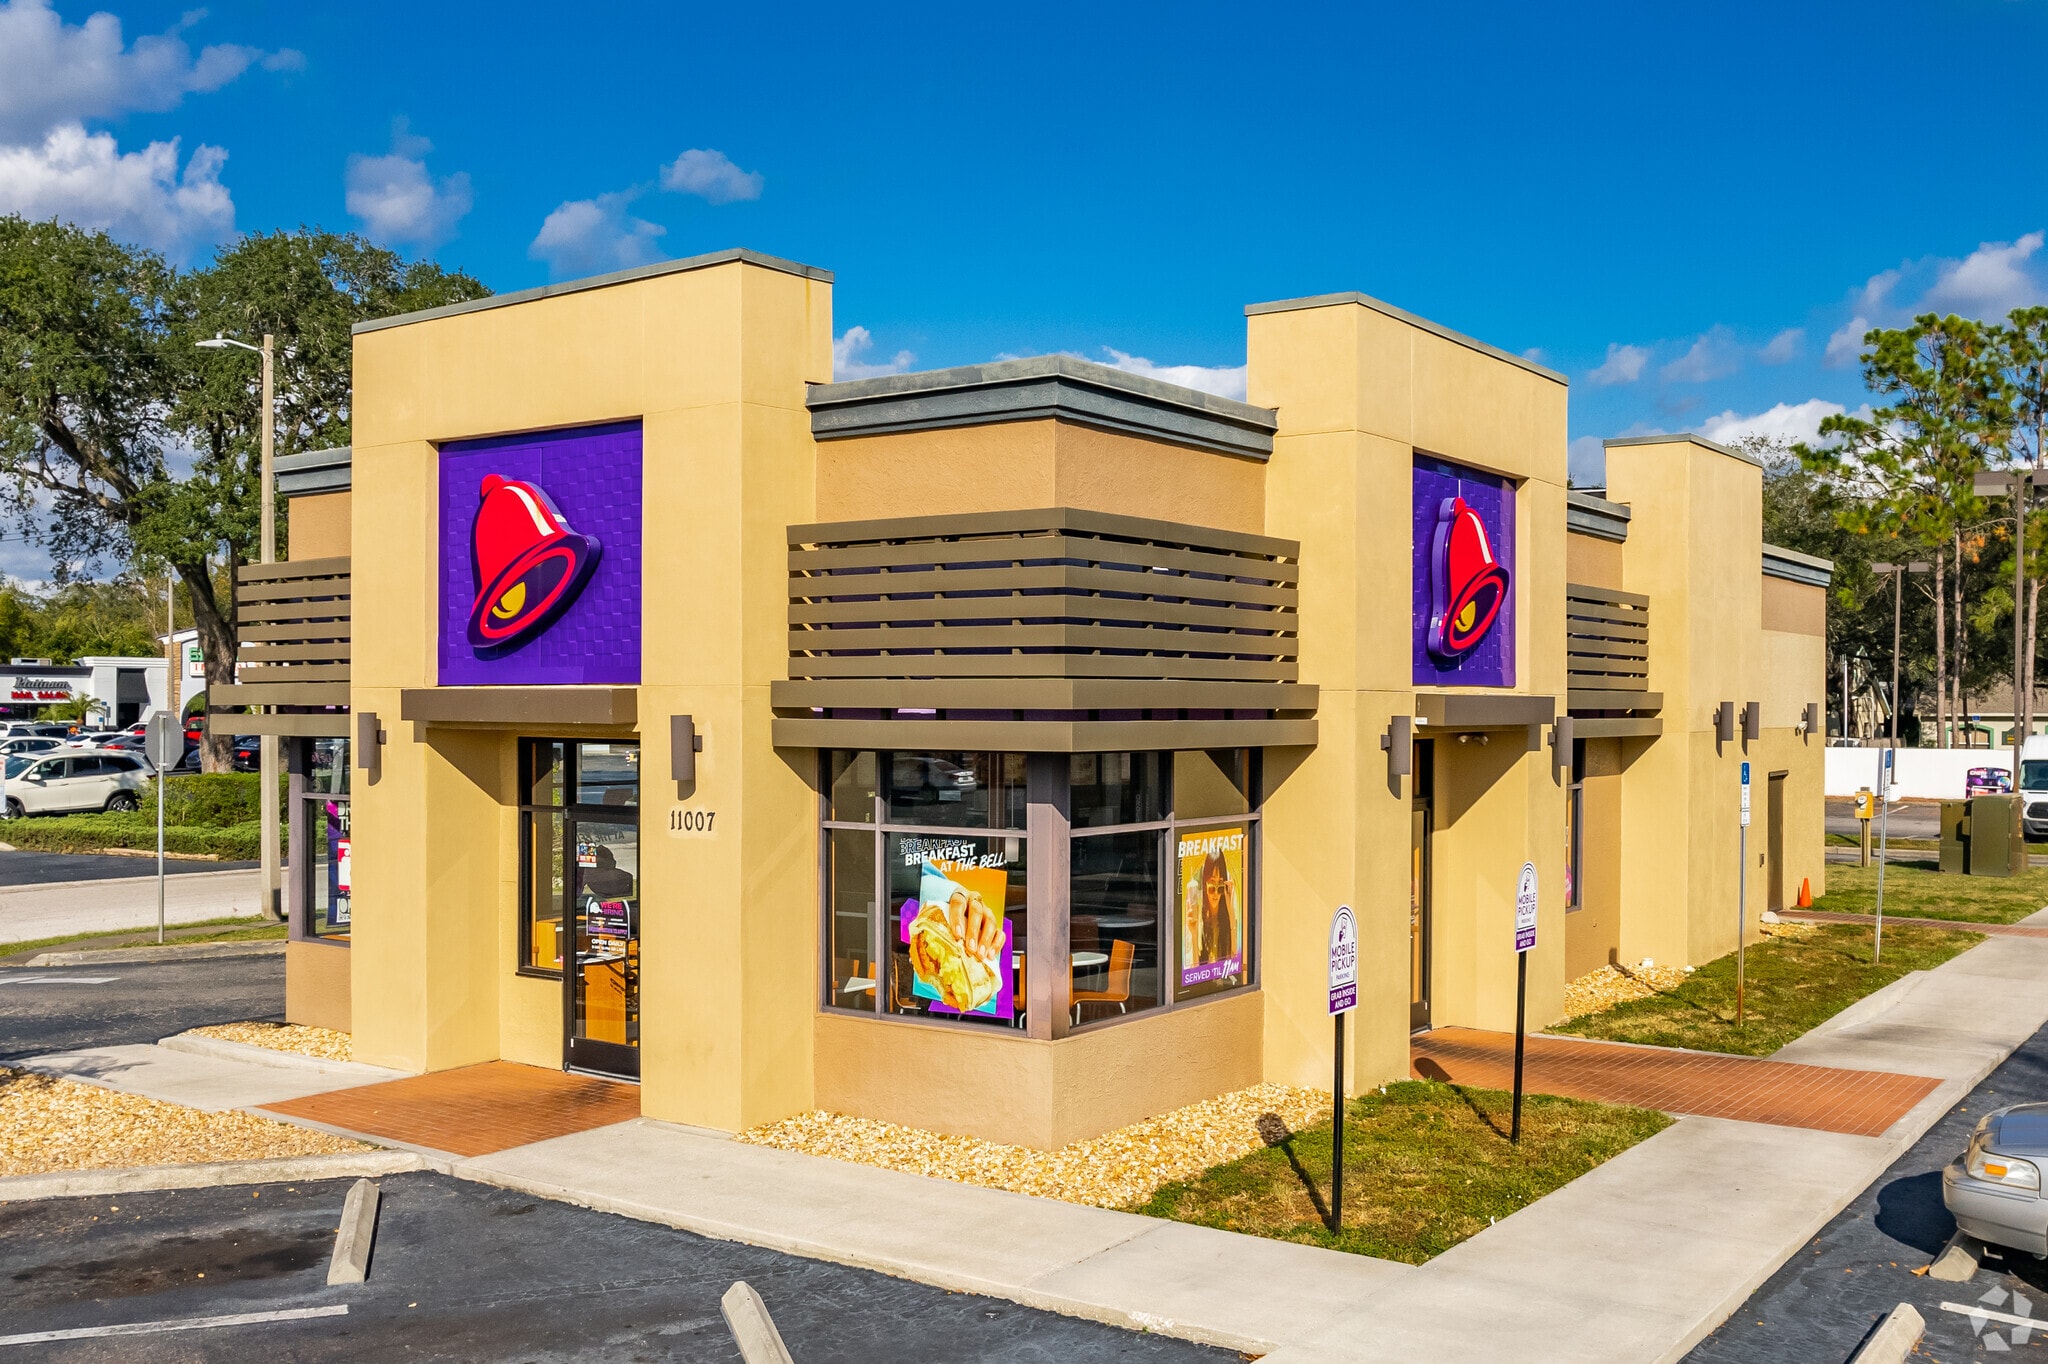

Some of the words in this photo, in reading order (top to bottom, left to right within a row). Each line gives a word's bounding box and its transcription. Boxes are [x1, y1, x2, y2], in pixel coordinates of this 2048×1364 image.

[670, 810, 716, 831] 11007
[905, 843, 976, 866] BREAKFAST
[1178, 833, 1244, 858] BREAKFAST
[940, 861, 953, 873] AT
[955, 856, 978, 873] THE
[979, 851, 1008, 870] BELL.
[1519, 892, 1536, 904] MOBILE
[1518, 903, 1536, 915] PICKUP
[1331, 941, 1355, 959] MOBILE
[1331, 955, 1355, 972] PICKUP
[1184, 969, 1211, 984] SERVED
